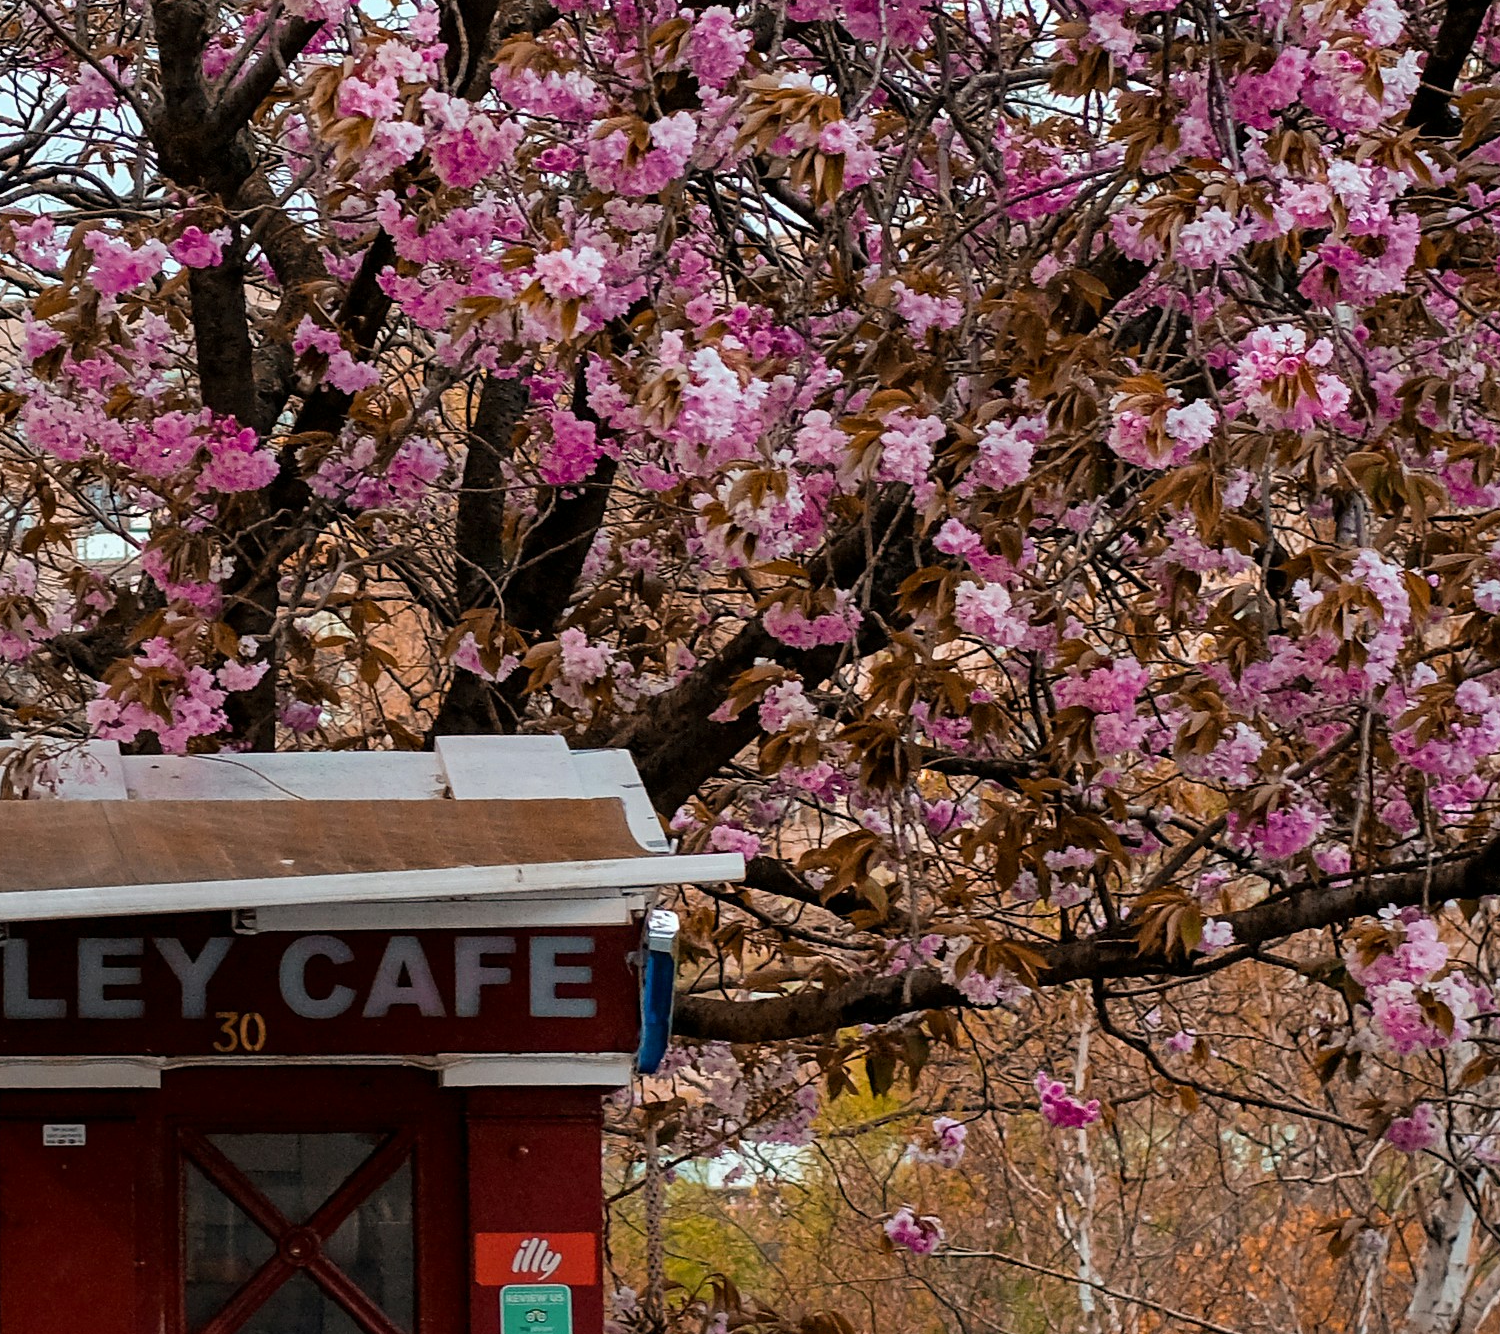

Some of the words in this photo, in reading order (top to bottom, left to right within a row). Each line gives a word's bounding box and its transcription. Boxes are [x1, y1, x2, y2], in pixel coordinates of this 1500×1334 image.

[278, 934, 598, 1019] CAFE
[212, 1011, 267, 1052] 30
[511, 1237, 562, 1281] illy
